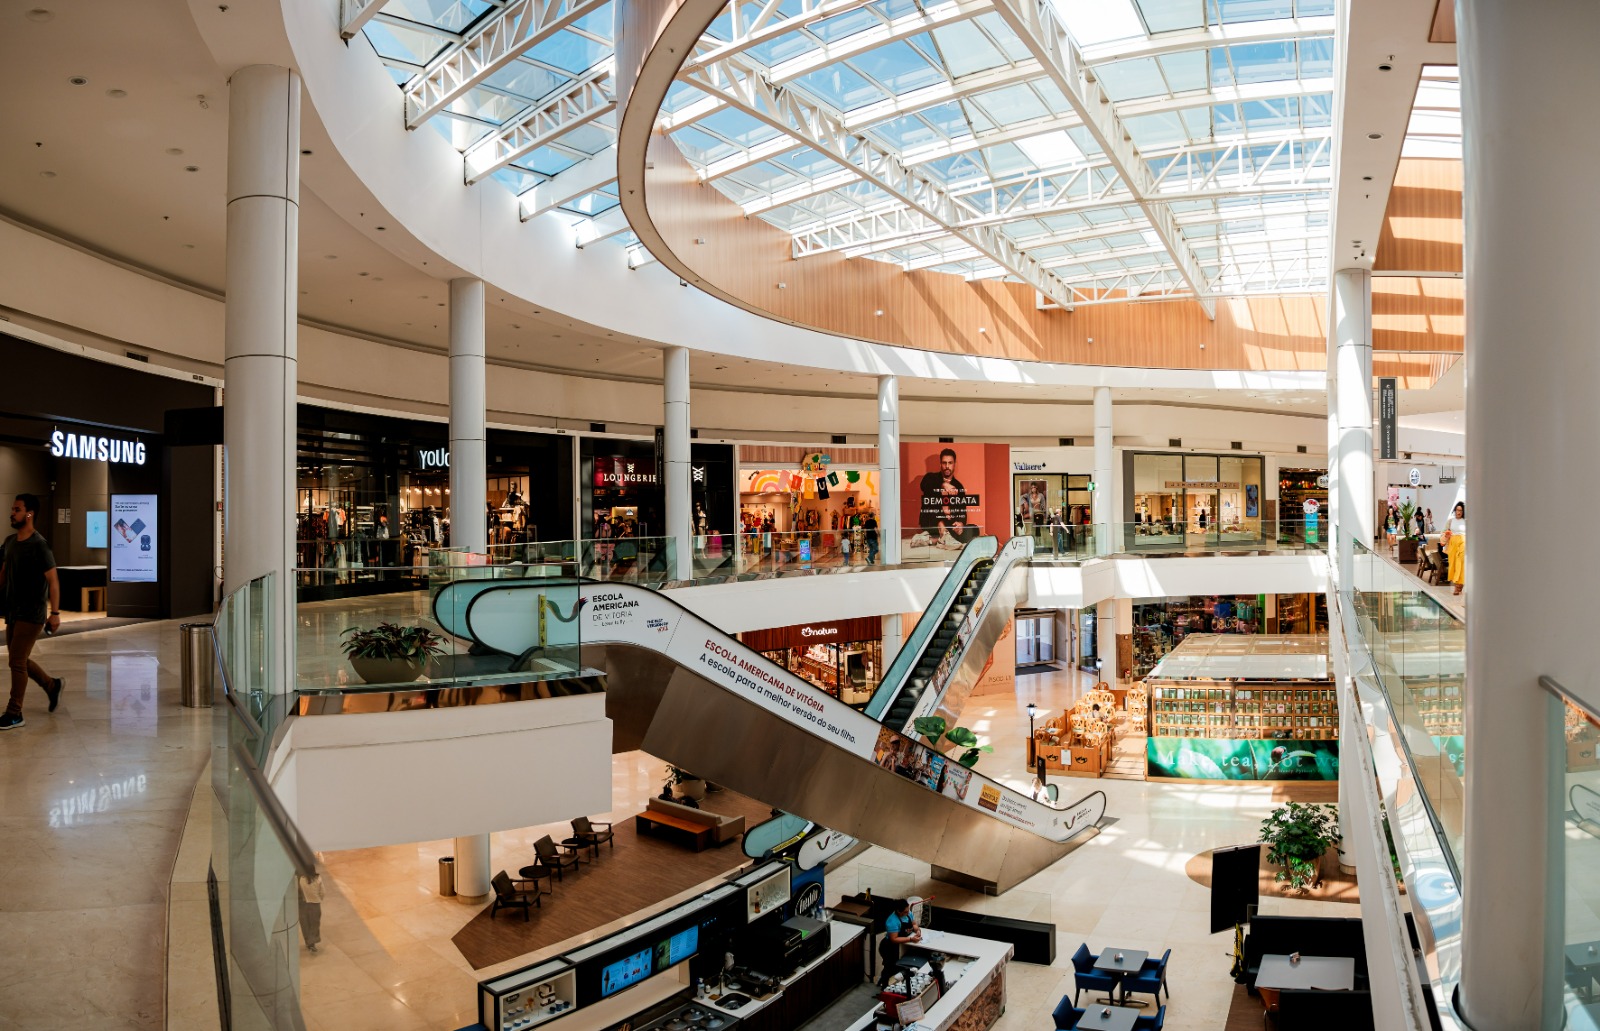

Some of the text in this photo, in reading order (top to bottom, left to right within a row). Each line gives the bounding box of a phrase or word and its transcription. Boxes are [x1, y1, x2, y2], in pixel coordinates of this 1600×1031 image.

[52, 430, 146, 465] SAMSUNG
[604, 473, 656, 483] LOUNGERIE
[923, 496, 977, 505] DEMOCRATA
[592, 593, 623, 602] ESCOLA
[592, 601, 639, 611] AMERICANA
[592, 613, 603, 622] DE
[812, 628, 838, 636] natura
[705, 639, 825, 713] ESCOLA AMERICANA DE VITÓRIA
[699, 652, 856, 744] A escola para a melhor versão do seu filho.
[1222, 754, 1258, 770] tea,
